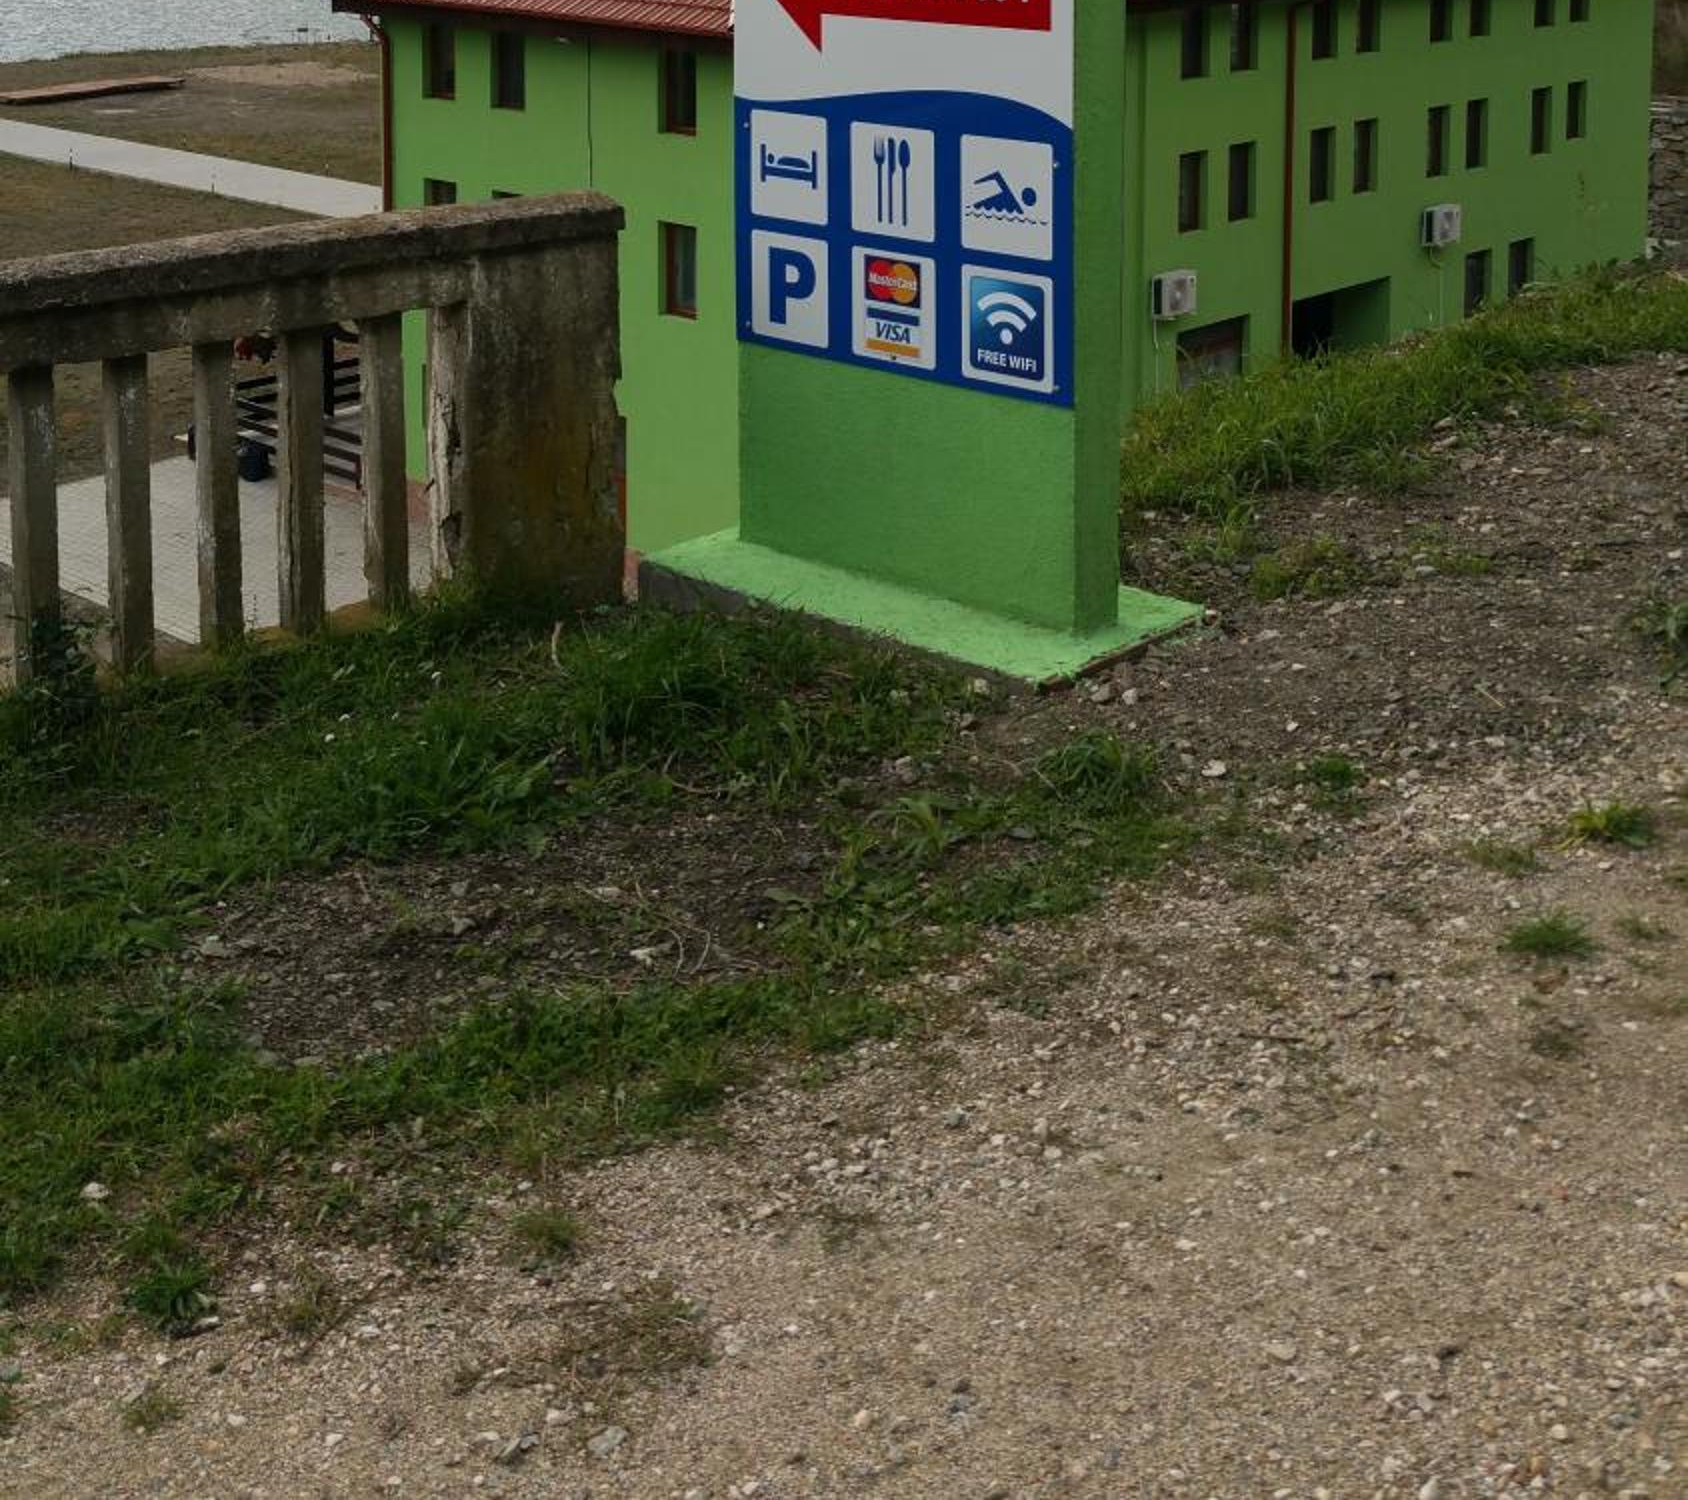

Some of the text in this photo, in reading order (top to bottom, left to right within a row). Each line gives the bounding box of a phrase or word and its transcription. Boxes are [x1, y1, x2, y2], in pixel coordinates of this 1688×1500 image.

[767, 246, 817, 325] P
[868, 271, 918, 292] MasterCard
[875, 321, 911, 344] VISA
[977, 348, 1038, 373] FREE WIFI
